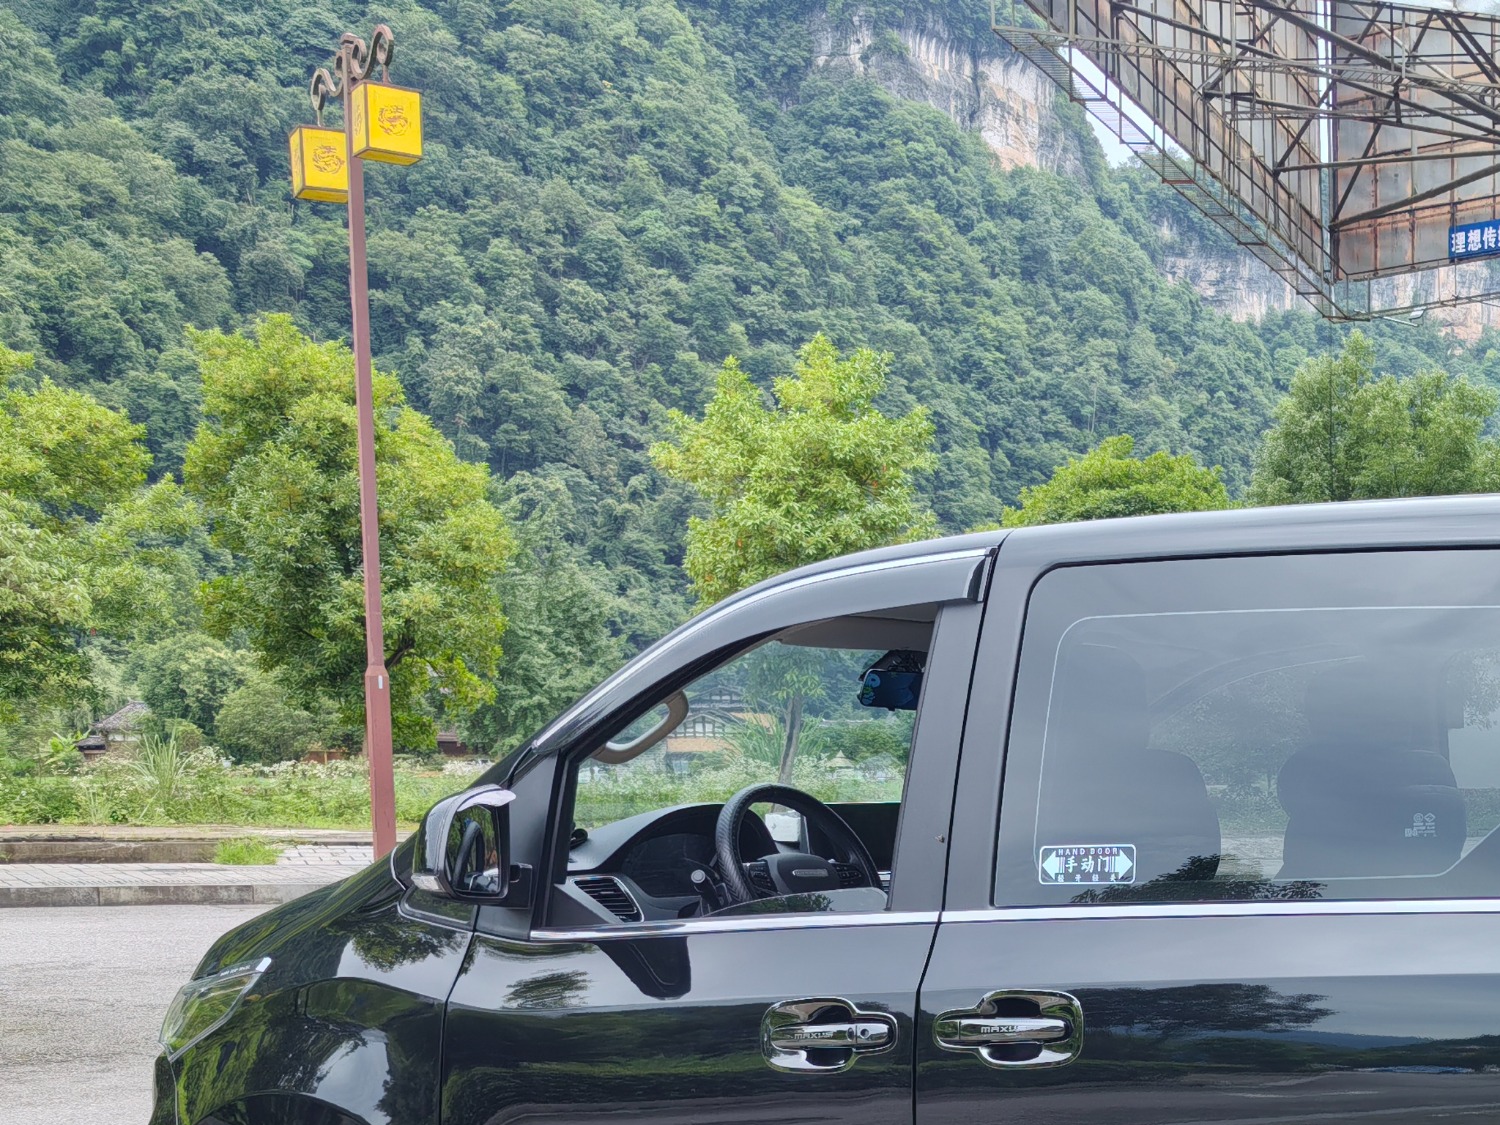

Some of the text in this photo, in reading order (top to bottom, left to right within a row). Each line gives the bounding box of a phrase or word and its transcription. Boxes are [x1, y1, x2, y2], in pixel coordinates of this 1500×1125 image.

[1058, 847, 1118, 856] HAND DOOR
[1065, 855, 1109, 873] 手动门
